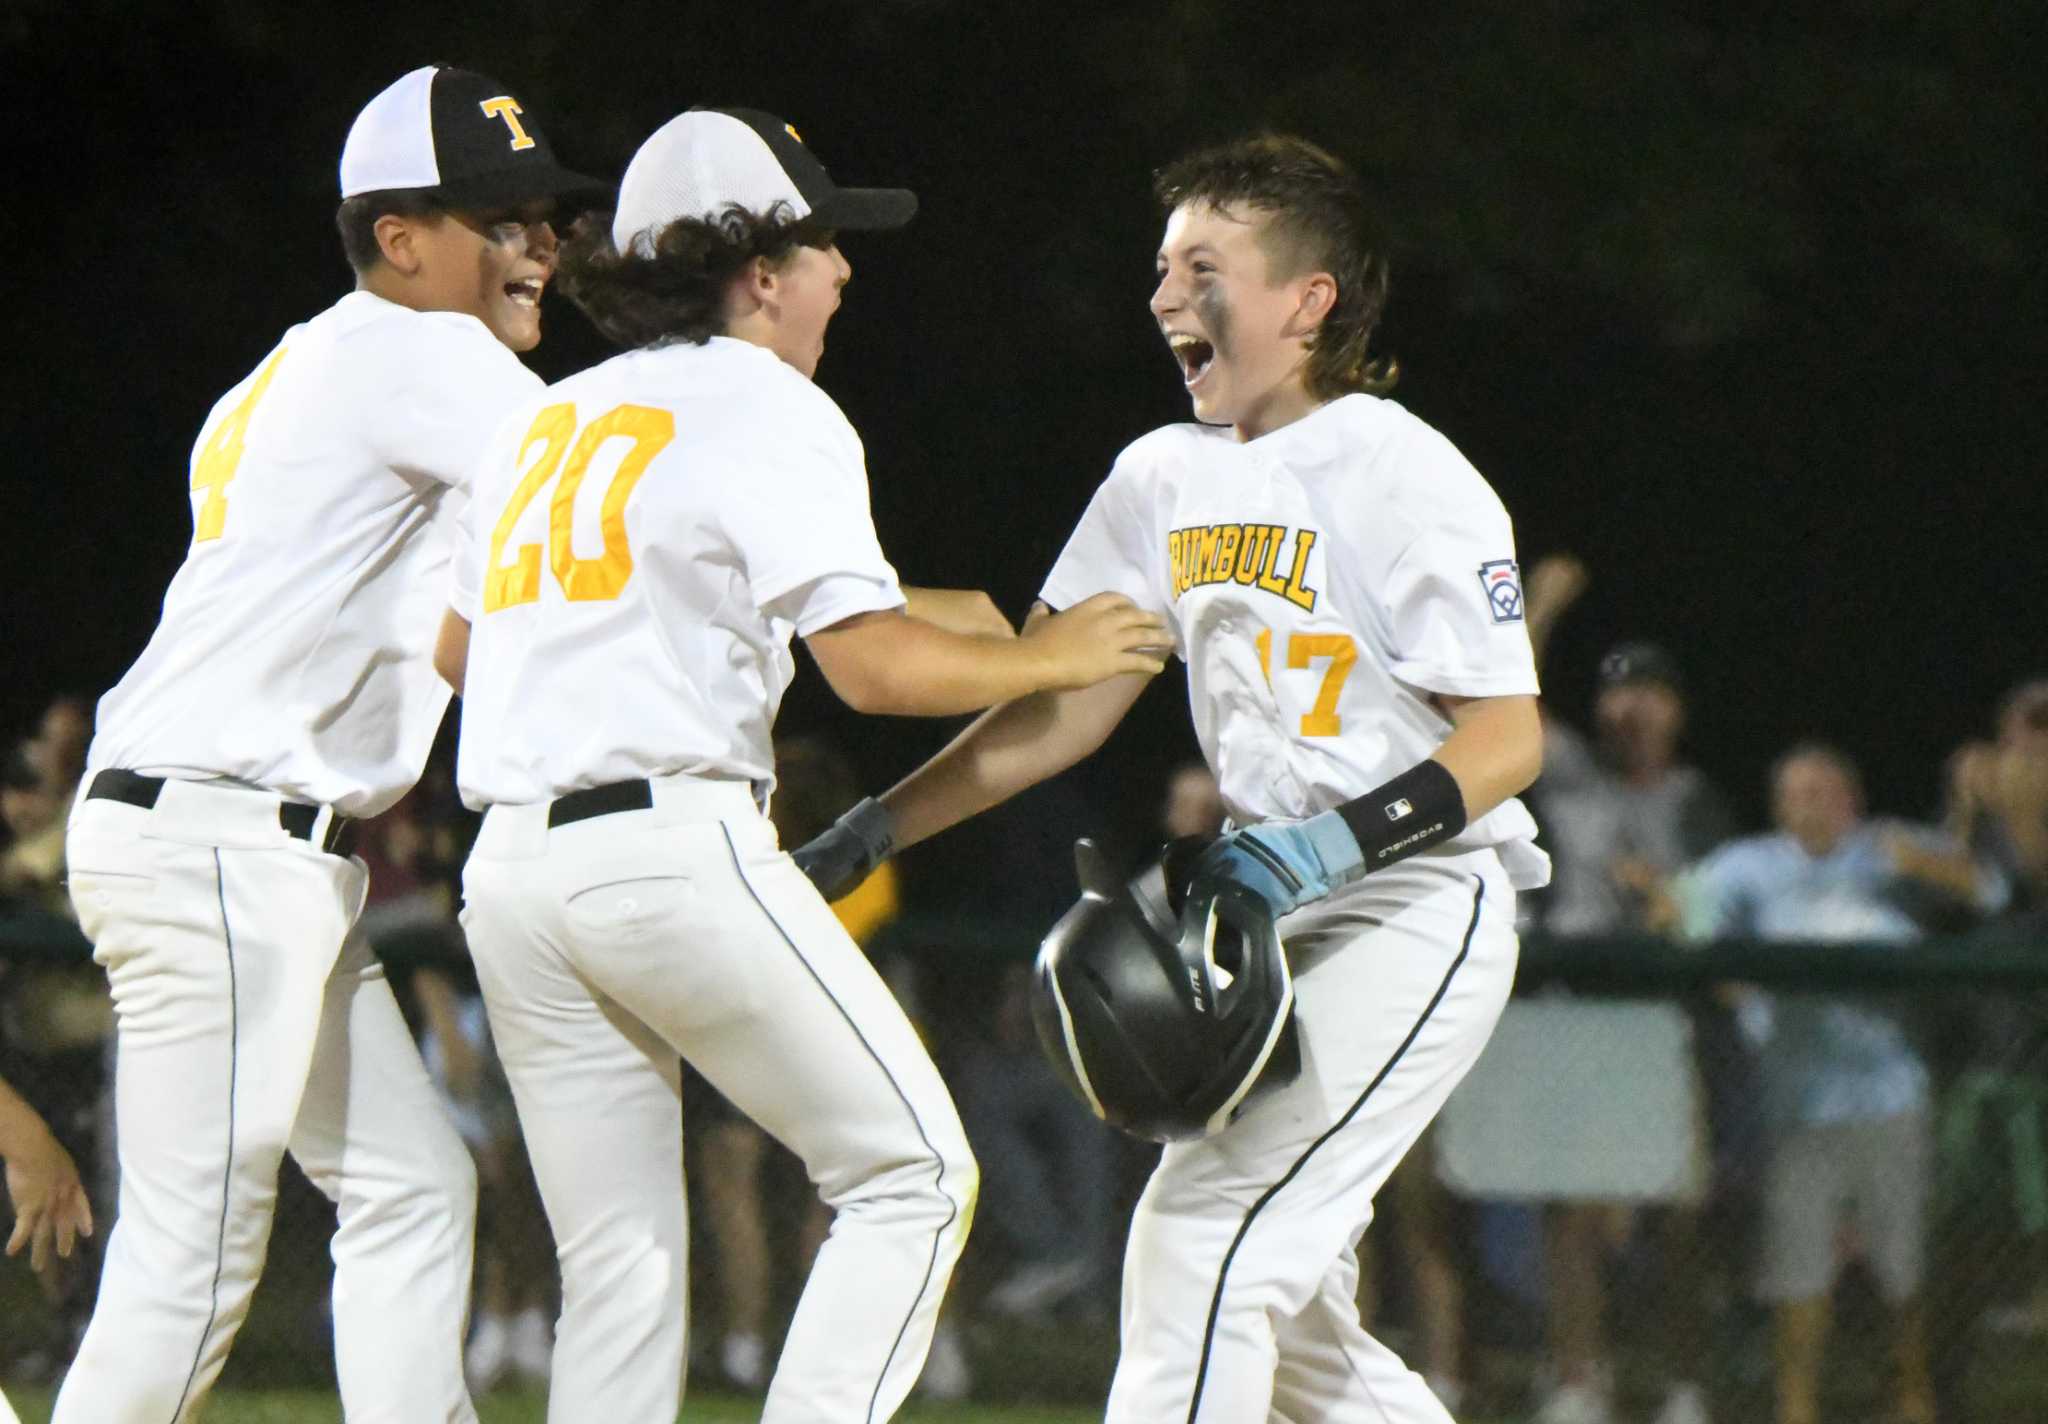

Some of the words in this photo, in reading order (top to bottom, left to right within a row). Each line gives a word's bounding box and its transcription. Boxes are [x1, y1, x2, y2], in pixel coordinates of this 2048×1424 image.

[479, 96, 535, 150] T
[190, 347, 288, 543] 4
[484, 403, 676, 614] 20
[1168, 523, 1318, 614] RUMBULL
